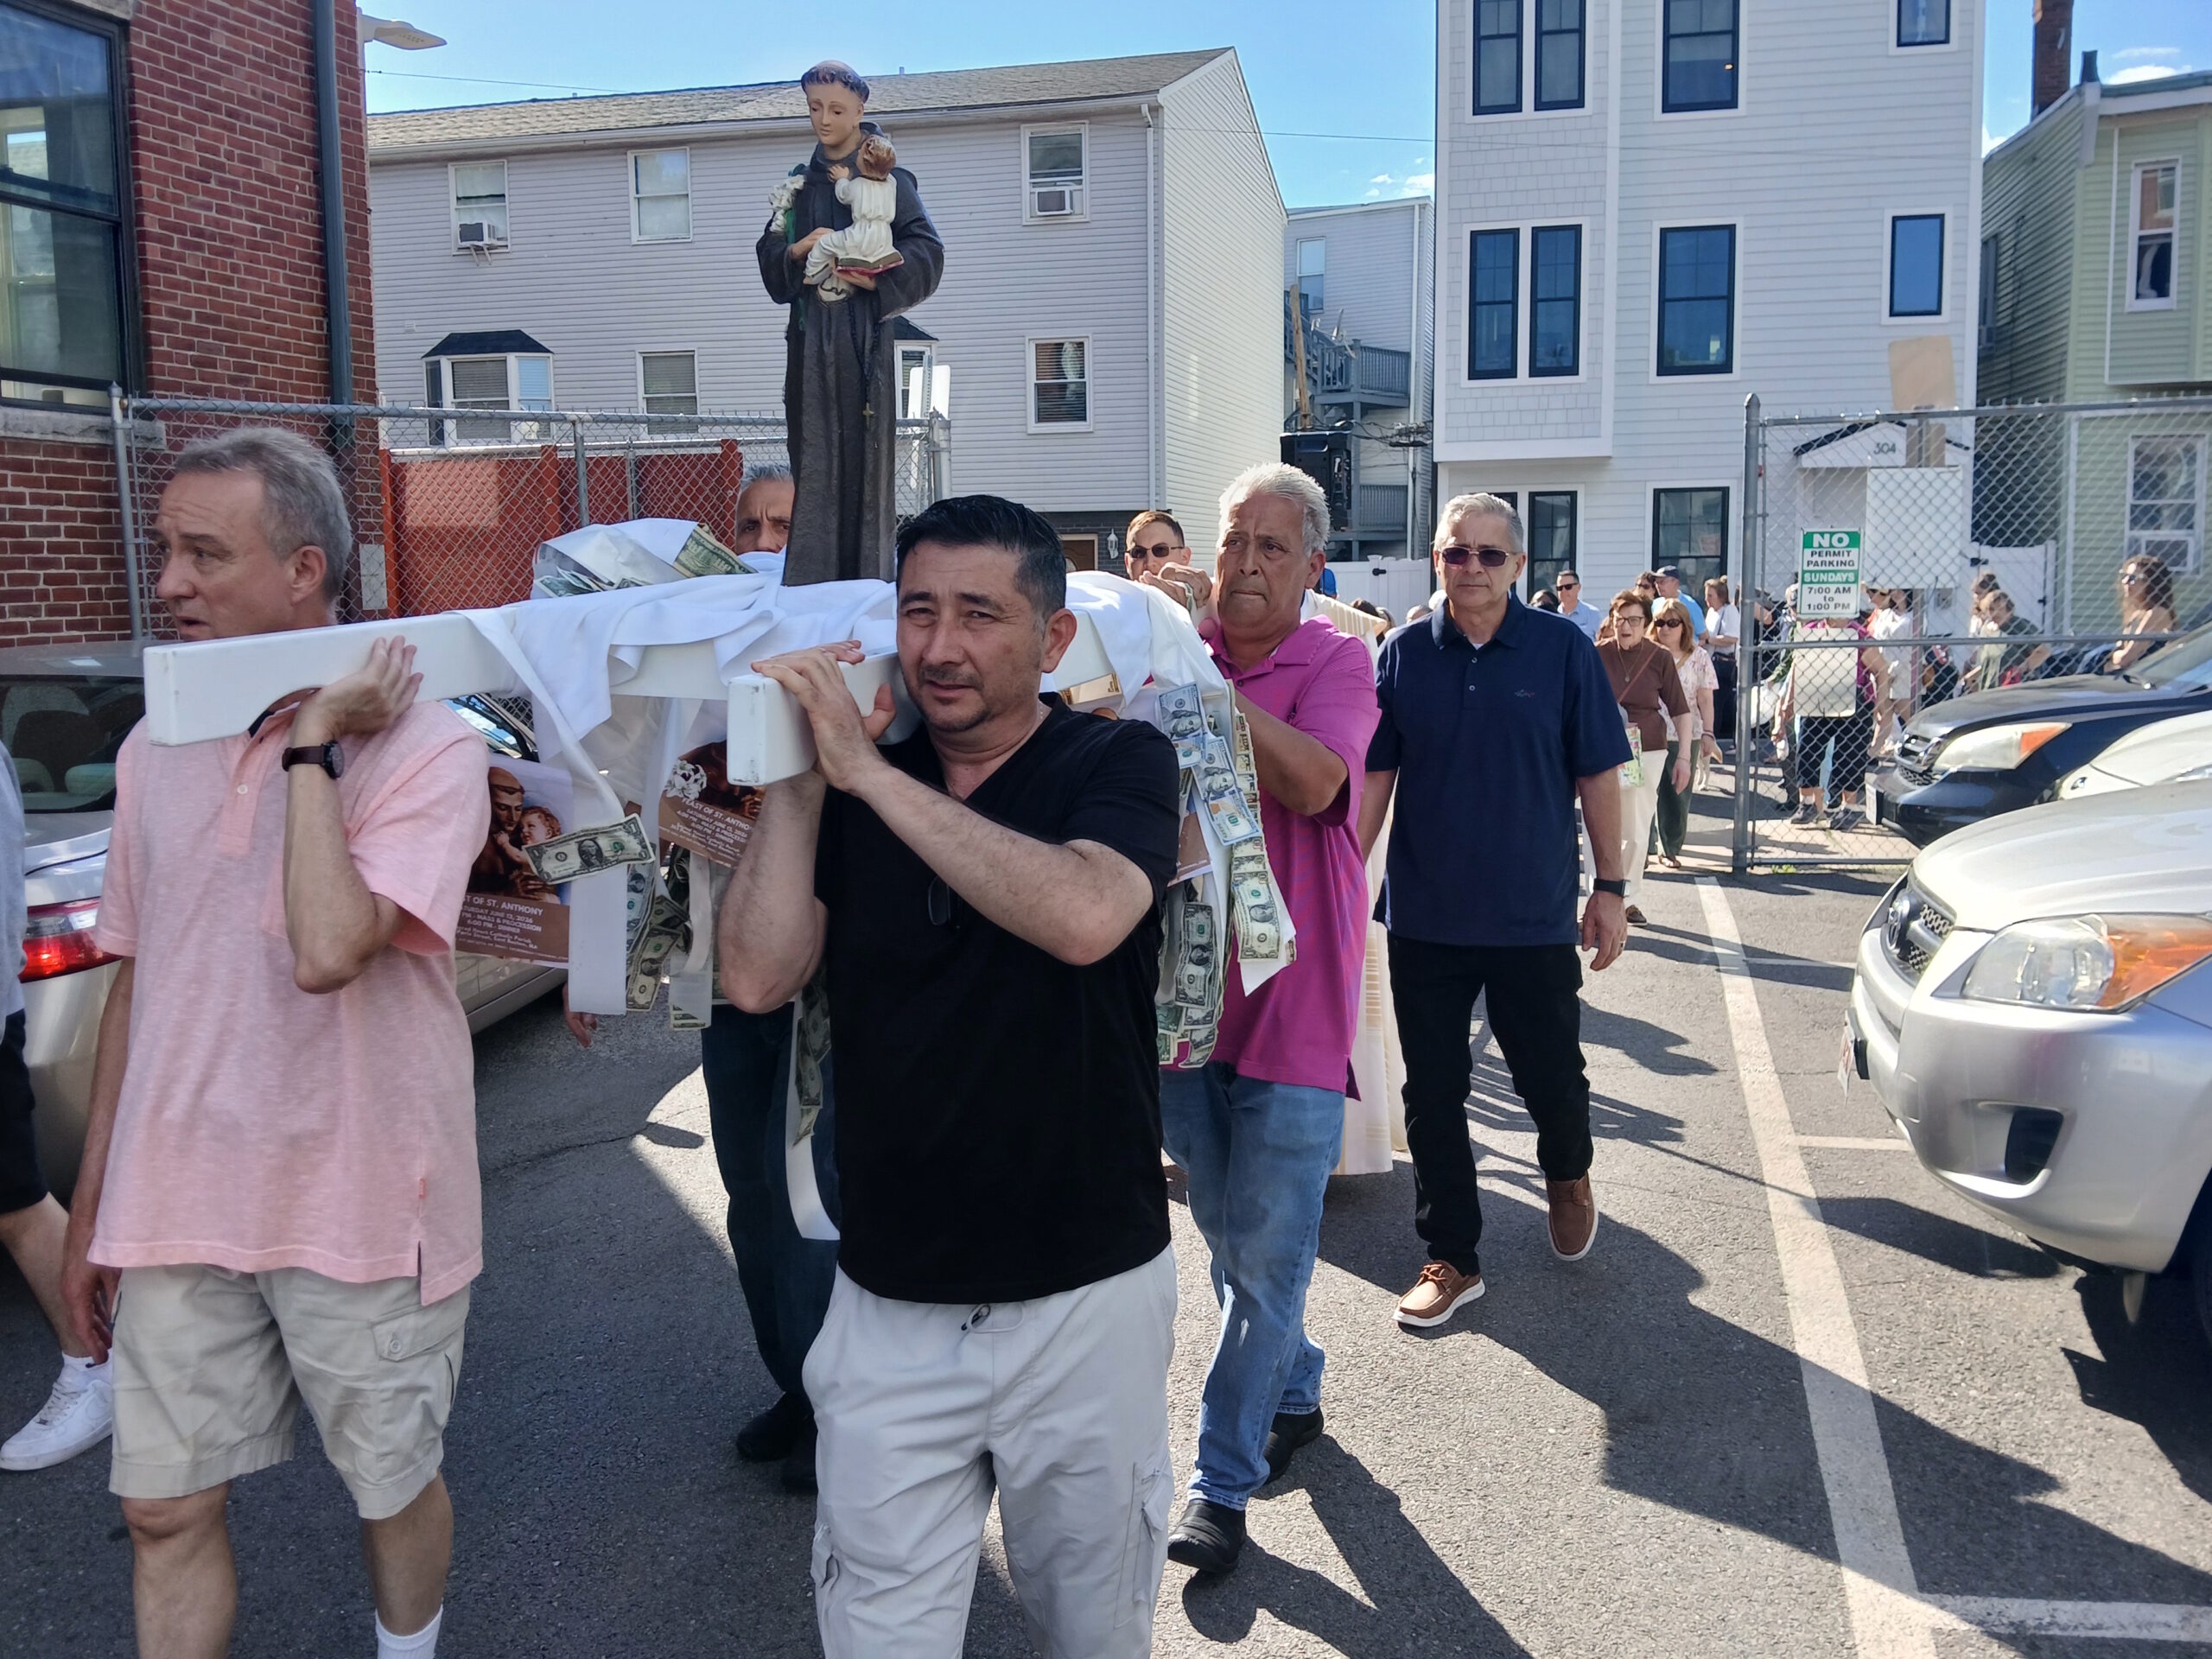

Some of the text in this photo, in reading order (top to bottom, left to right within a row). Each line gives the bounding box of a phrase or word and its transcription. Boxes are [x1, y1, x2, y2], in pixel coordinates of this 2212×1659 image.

[1813, 533, 1849, 548] NO
[1804, 572, 1855, 582] SUNDAYS
[682, 798, 702, 810] FEAST
[714, 811, 723, 820] ST.
[725, 817, 750, 830] ANTHO
[486, 899, 499, 908] ST.
[502, 902, 543, 916] ANTHONY
[503, 919, 542, 931] PROCESSION
